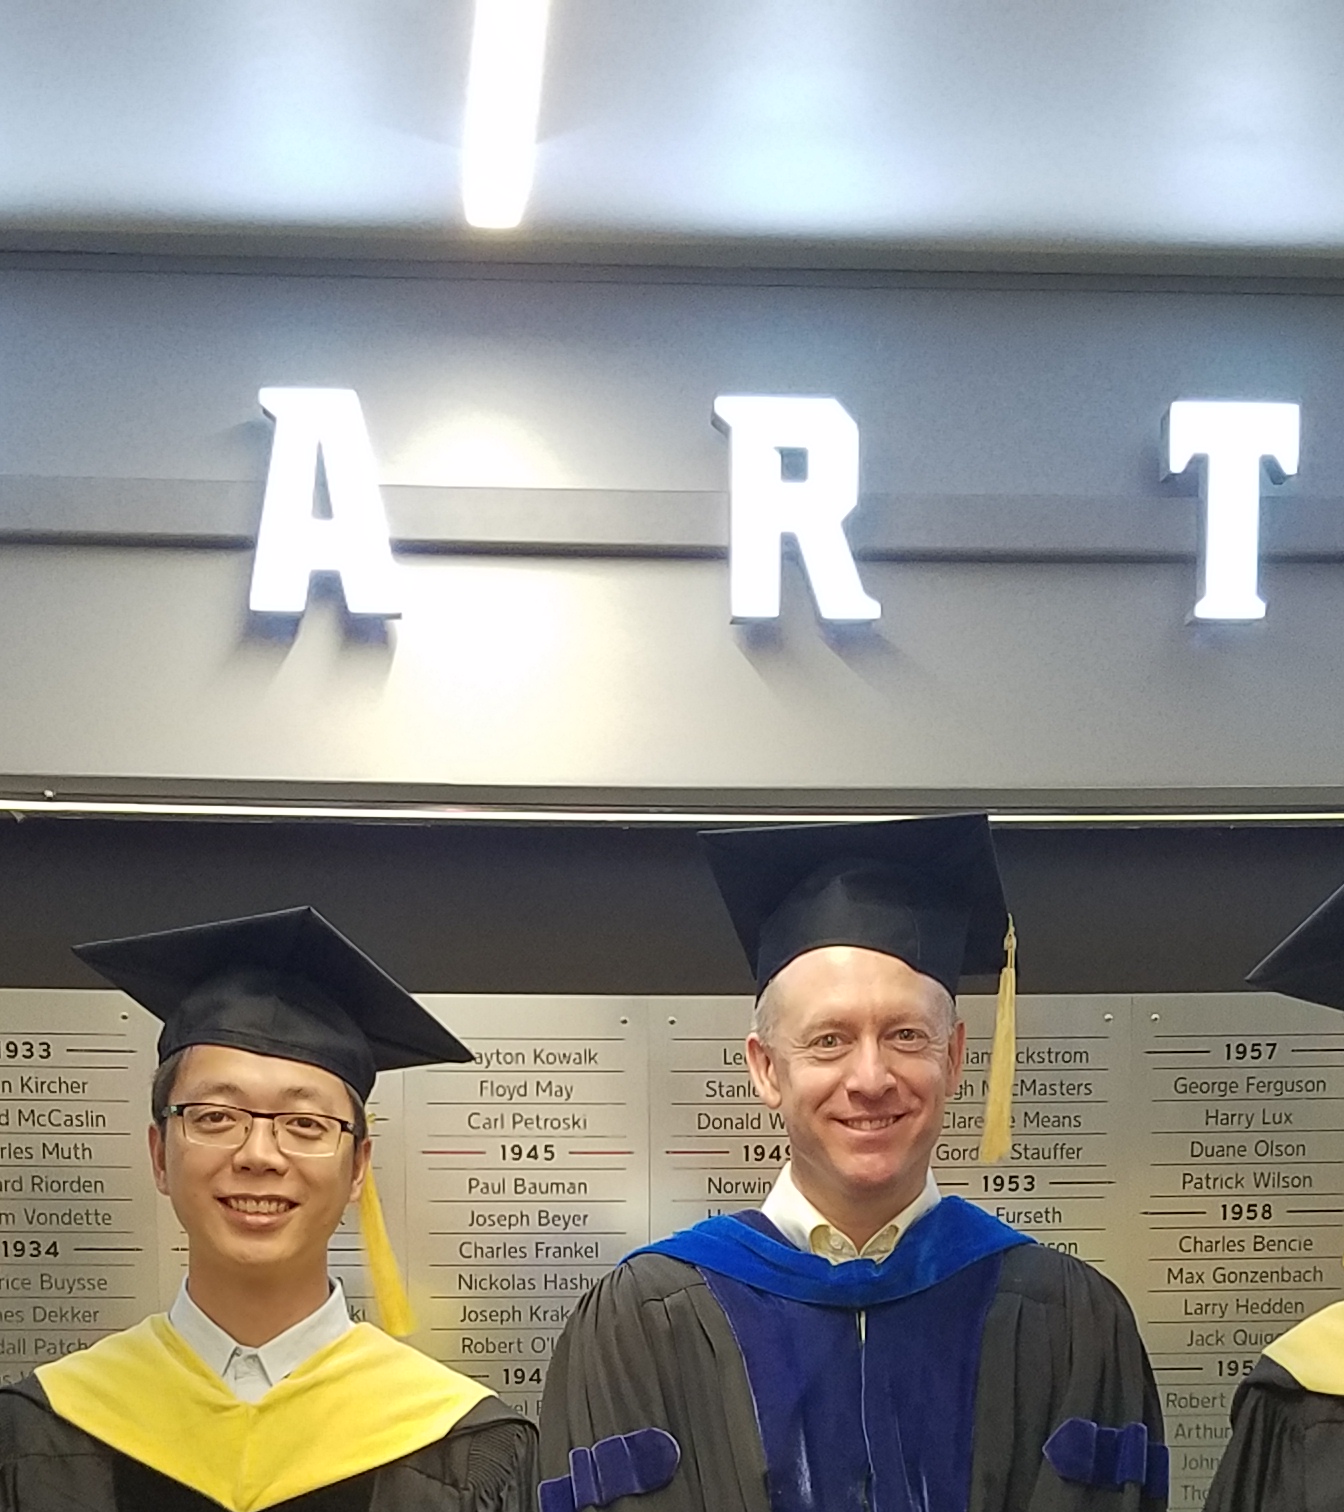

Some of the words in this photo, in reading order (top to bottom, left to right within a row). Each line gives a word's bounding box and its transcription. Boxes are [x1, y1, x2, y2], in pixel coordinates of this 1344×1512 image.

[1225, 1042, 1278, 1061] 1957
[19, 1075, 88, 1095] Kircher
[479, 1079, 528, 1102] Floyd
[535, 1080, 574, 1102] May
[1173, 1076, 1240, 1098] George
[1245, 1075, 1327, 1097] Ferguson
[467, 1111, 505, 1130] Carl
[511, 1112, 587, 1131] Petroski
[1204, 1108, 1255, 1130] Harry
[1261, 1107, 1293, 1126] Lux
[500, 1143, 555, 1162] 1945
[30, 1174, 105, 1194] Riorden
[467, 1177, 506, 1195] Paul
[513, 1177, 588, 1196] Bauman
[982, 1174, 1036, 1193] 1953
[1181, 1172, 1245, 1191] Patrick
[1252, 1171, 1313, 1189] Wilson
[1221, 1203, 1273, 1221] 1958
[1, 1240, 60, 1258] 1934
[458, 1240, 528, 1260] Charles
[534, 1241, 599, 1259] Frankel
[1178, 1235, 1246, 1254] Charles
[1252, 1234, 1314, 1253] Bencie
[1166, 1266, 1205, 1285] Max
[1212, 1265, 1324, 1285] Gonzenbach
[32, 1305, 100, 1324] Dekker
